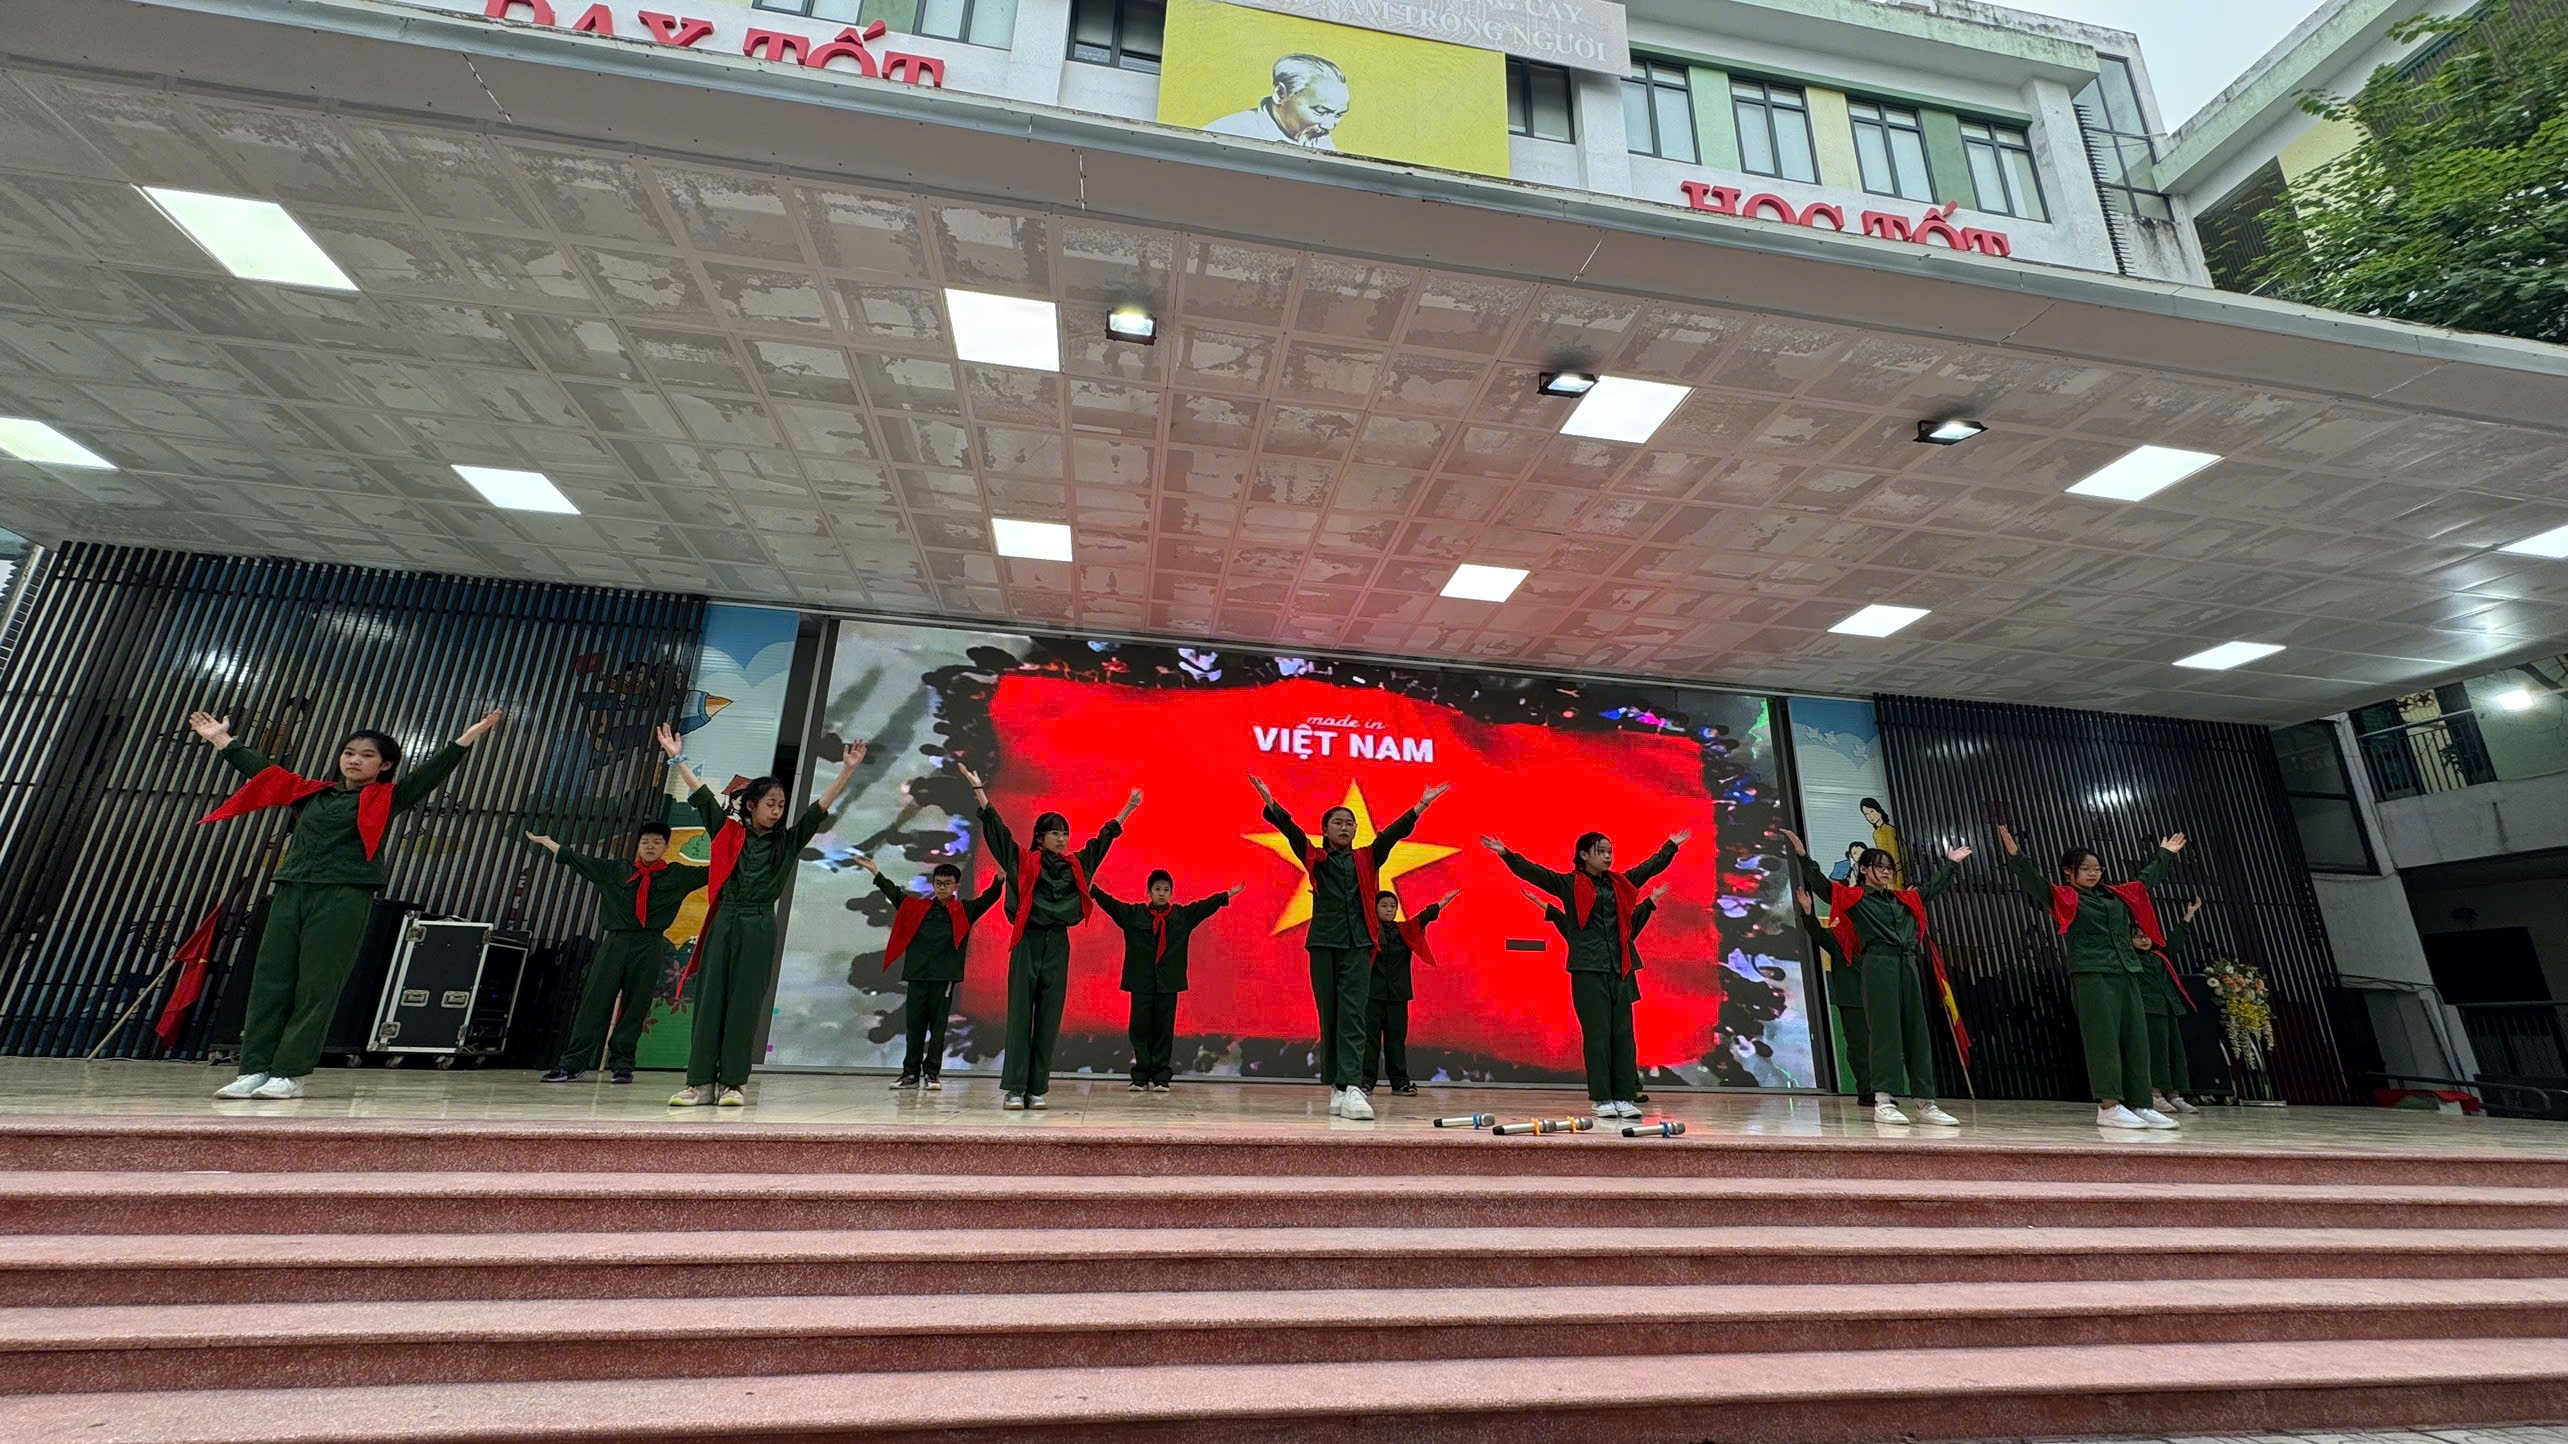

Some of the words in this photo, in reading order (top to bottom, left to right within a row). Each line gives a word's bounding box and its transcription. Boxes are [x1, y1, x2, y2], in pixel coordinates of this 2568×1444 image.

[1306, 714, 1360, 729] made
[1364, 718, 1386, 730] in
[1252, 723, 1338, 760] VIỆT
[1350, 733, 1434, 763] NAM
